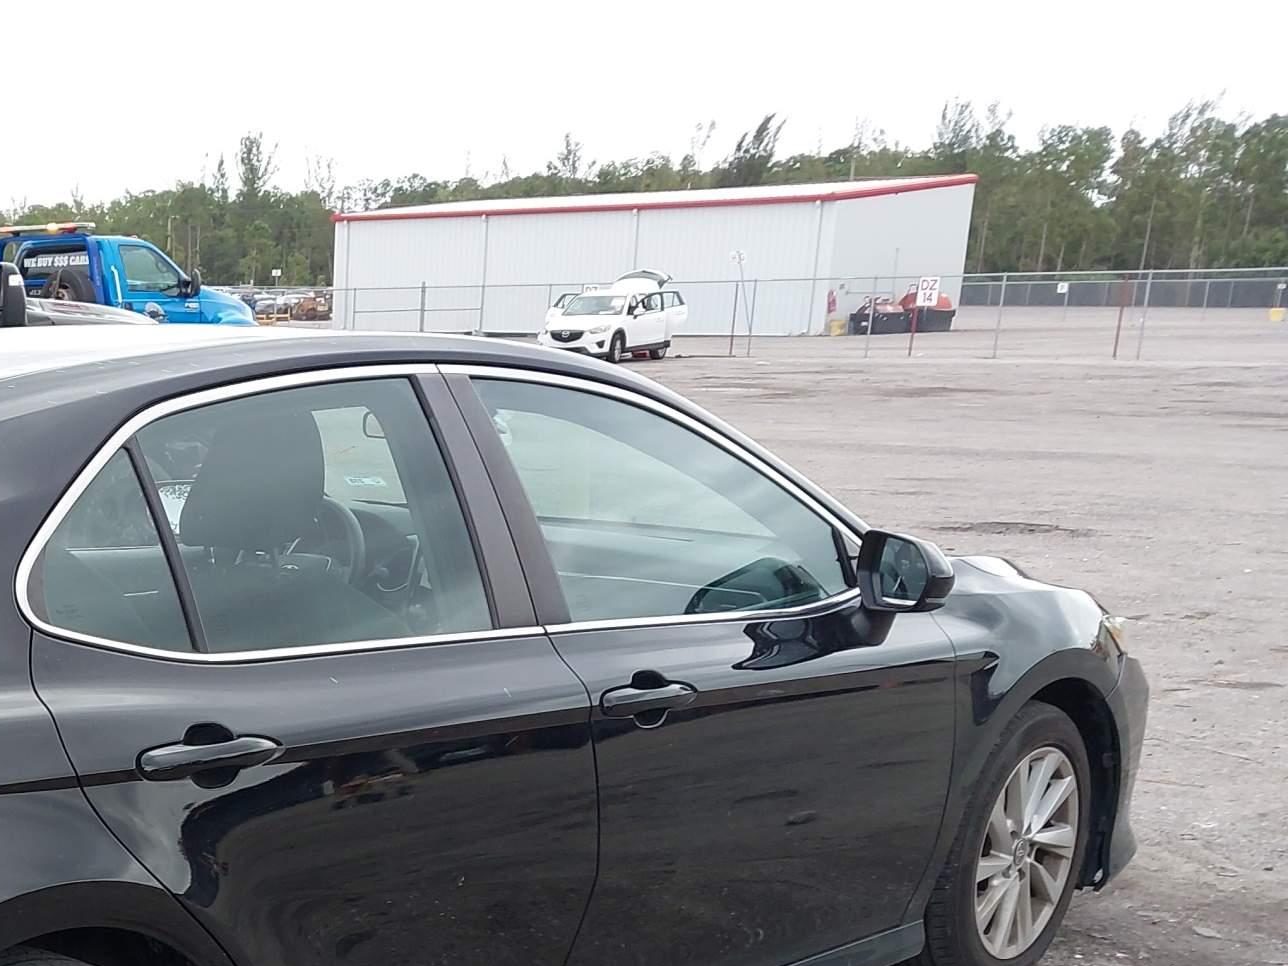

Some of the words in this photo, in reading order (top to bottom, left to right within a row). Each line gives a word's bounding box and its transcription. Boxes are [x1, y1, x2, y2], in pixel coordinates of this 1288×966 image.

[24, 258, 36, 267] WE
[37, 257, 53, 267] BUY
[53, 255, 68, 267] $$$
[922, 279, 938, 291] DZ
[923, 292, 933, 304] 14
